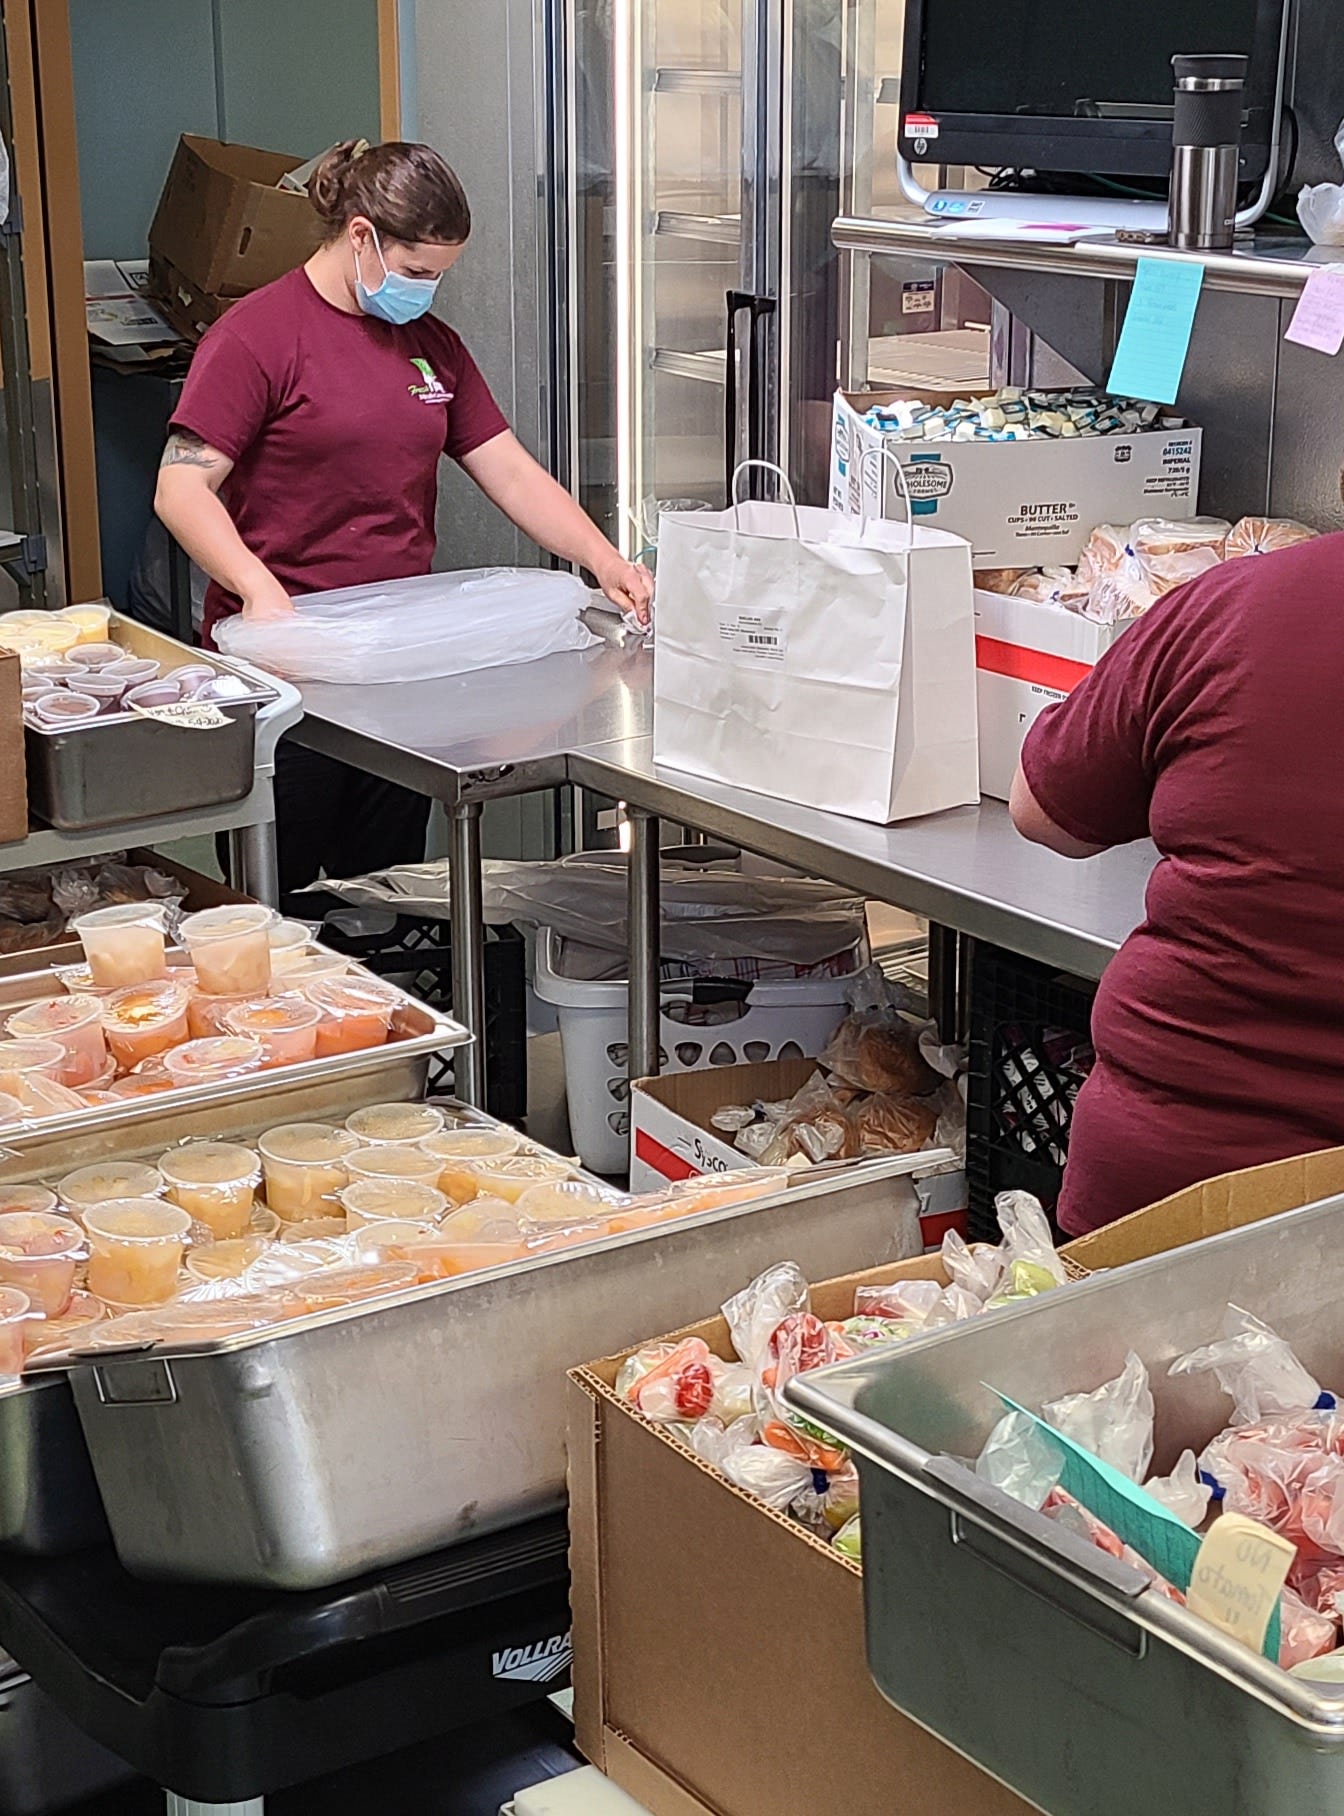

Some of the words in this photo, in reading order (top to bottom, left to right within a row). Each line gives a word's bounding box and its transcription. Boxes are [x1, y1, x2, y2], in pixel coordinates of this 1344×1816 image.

[1020, 503, 1067, 516] BUTTER
[694, 1138, 727, 1172] Sysco
[492, 1631, 573, 1675] VOLLRA
